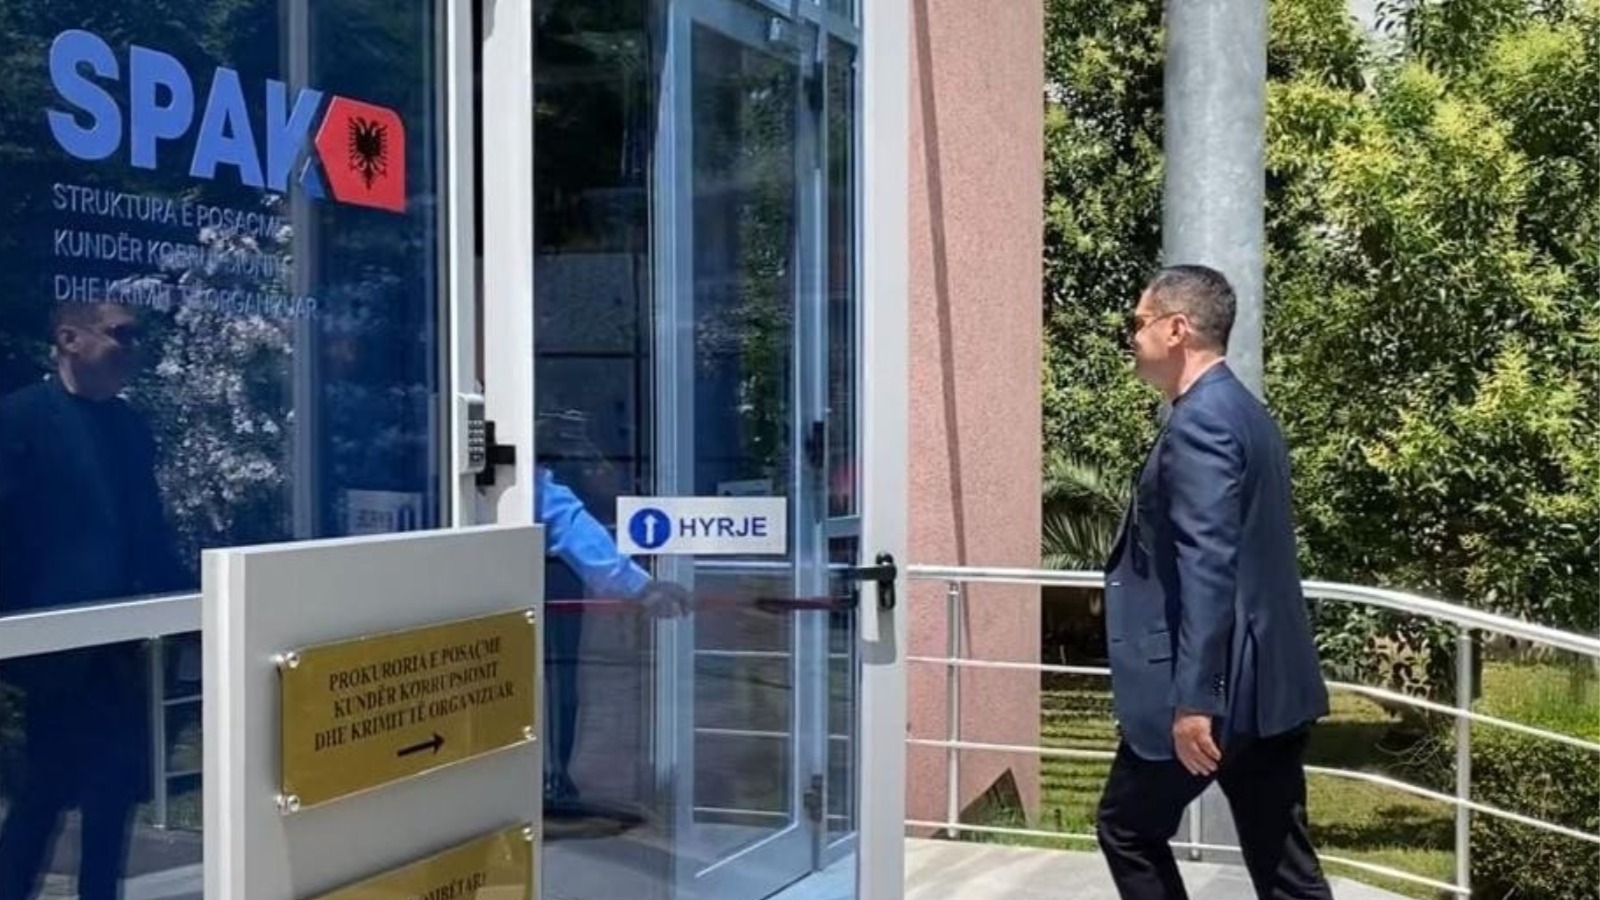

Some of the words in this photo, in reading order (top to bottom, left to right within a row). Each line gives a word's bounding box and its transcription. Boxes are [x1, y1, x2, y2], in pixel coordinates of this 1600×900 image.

[47, 29, 327, 198] SPAK
[53, 183, 178, 224] STRUKTURA
[182, 203, 195, 227] E
[54, 228, 143, 263] KUNDËR
[54, 274, 101, 304] DHE
[679, 517, 768, 537] HYRJE
[329, 654, 428, 692] PROKURORIA
[429, 651, 441, 669] E
[333, 684, 396, 718] KUNDËR
[400, 661, 498, 701] KORRUPSIONIT
[315, 725, 347, 752] DHE
[351, 710, 408, 741] KRIMIT
[429, 681, 514, 719] ORGANIZUAR
